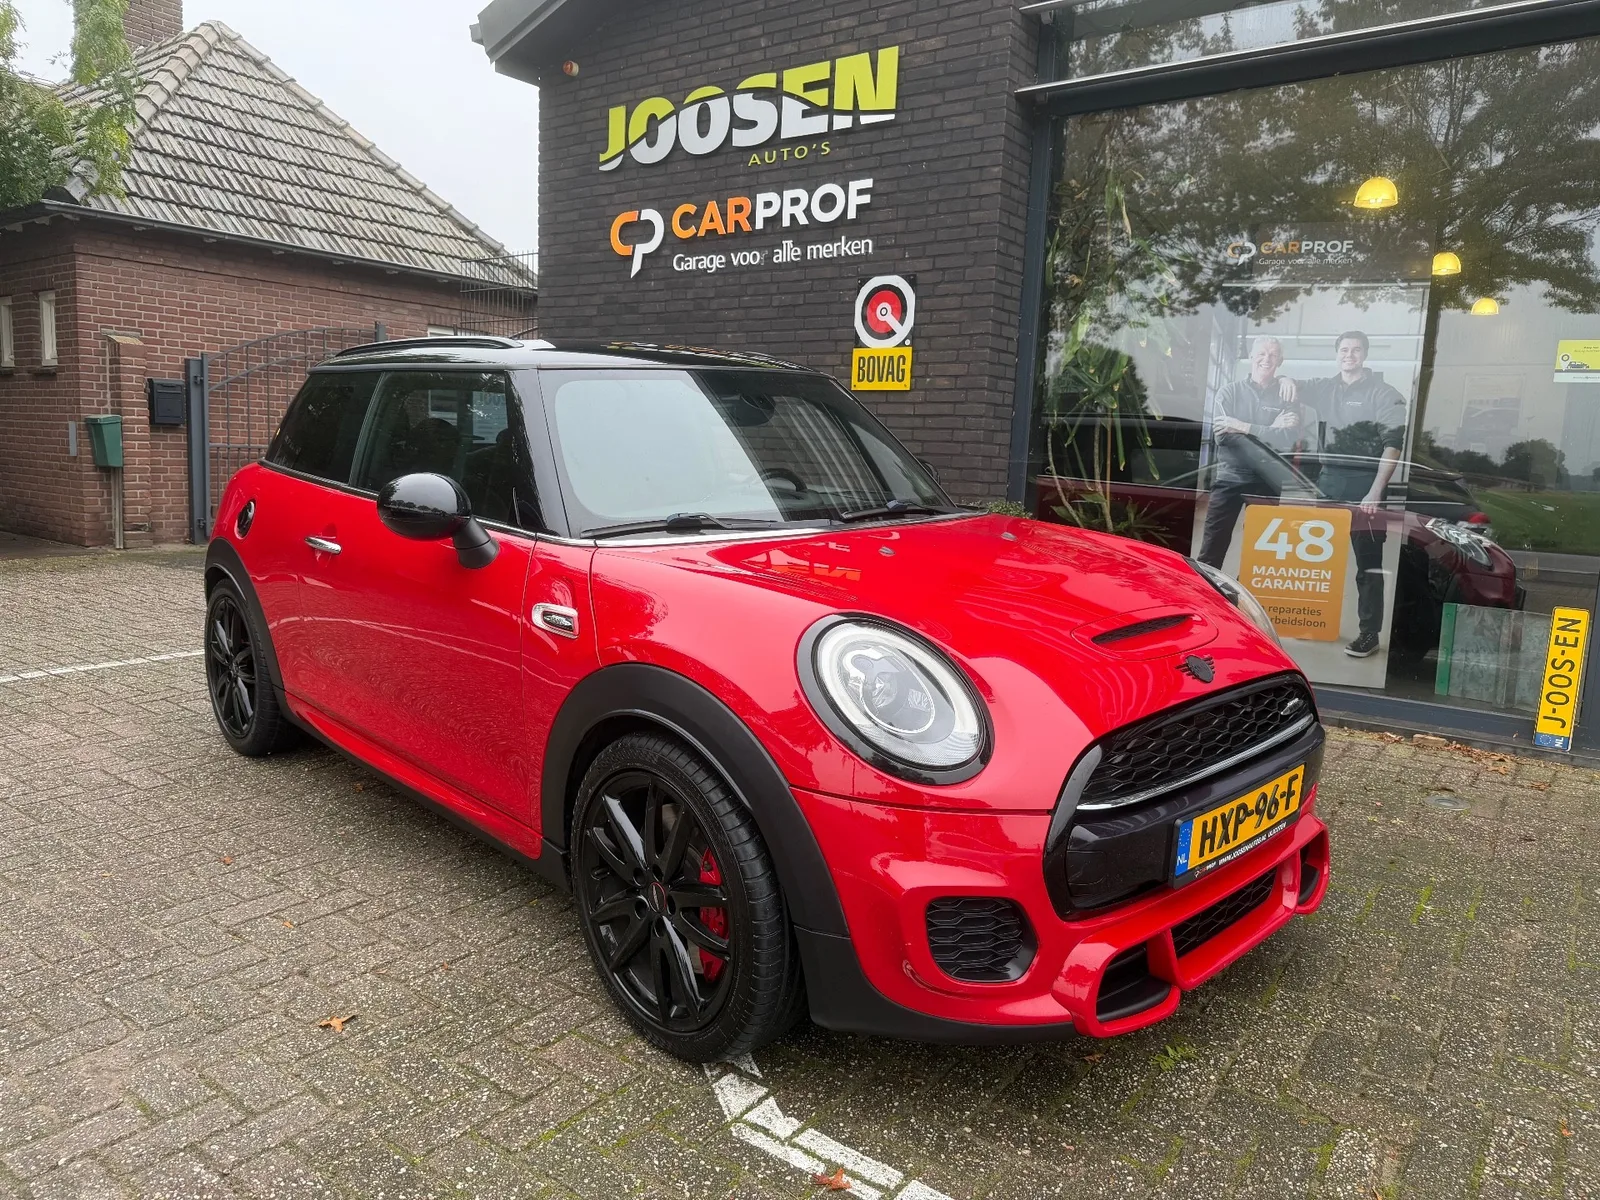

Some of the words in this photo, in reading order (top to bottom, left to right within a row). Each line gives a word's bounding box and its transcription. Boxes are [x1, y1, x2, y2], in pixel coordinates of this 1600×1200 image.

[598, 46, 899, 171] JOOSEN
[747, 141, 831, 166] AUTO'S
[671, 178, 874, 239] CARPROF
[672, 253, 726, 273] Garage
[773, 240, 801, 264] alle
[807, 235, 874, 260] merken
[1260, 240, 1354, 254] CARPROF
[1258, 257, 1286, 267] Garage
[1322, 256, 1354, 265] merken
[857, 354, 907, 383] BOVAG
[1253, 517, 1335, 563] 48
[1251, 577, 1330, 593] GARANTIE
[1252, 565, 1332, 580] MAANDEN
[1268, 604, 1322, 617] reparaties
[1269, 615, 1326, 629] rbeidsloon
[1542, 617, 1582, 729] J-OOS-EN
[1198, 773, 1299, 859] HXP-96-F
[1176, 853, 1188, 866] NL
